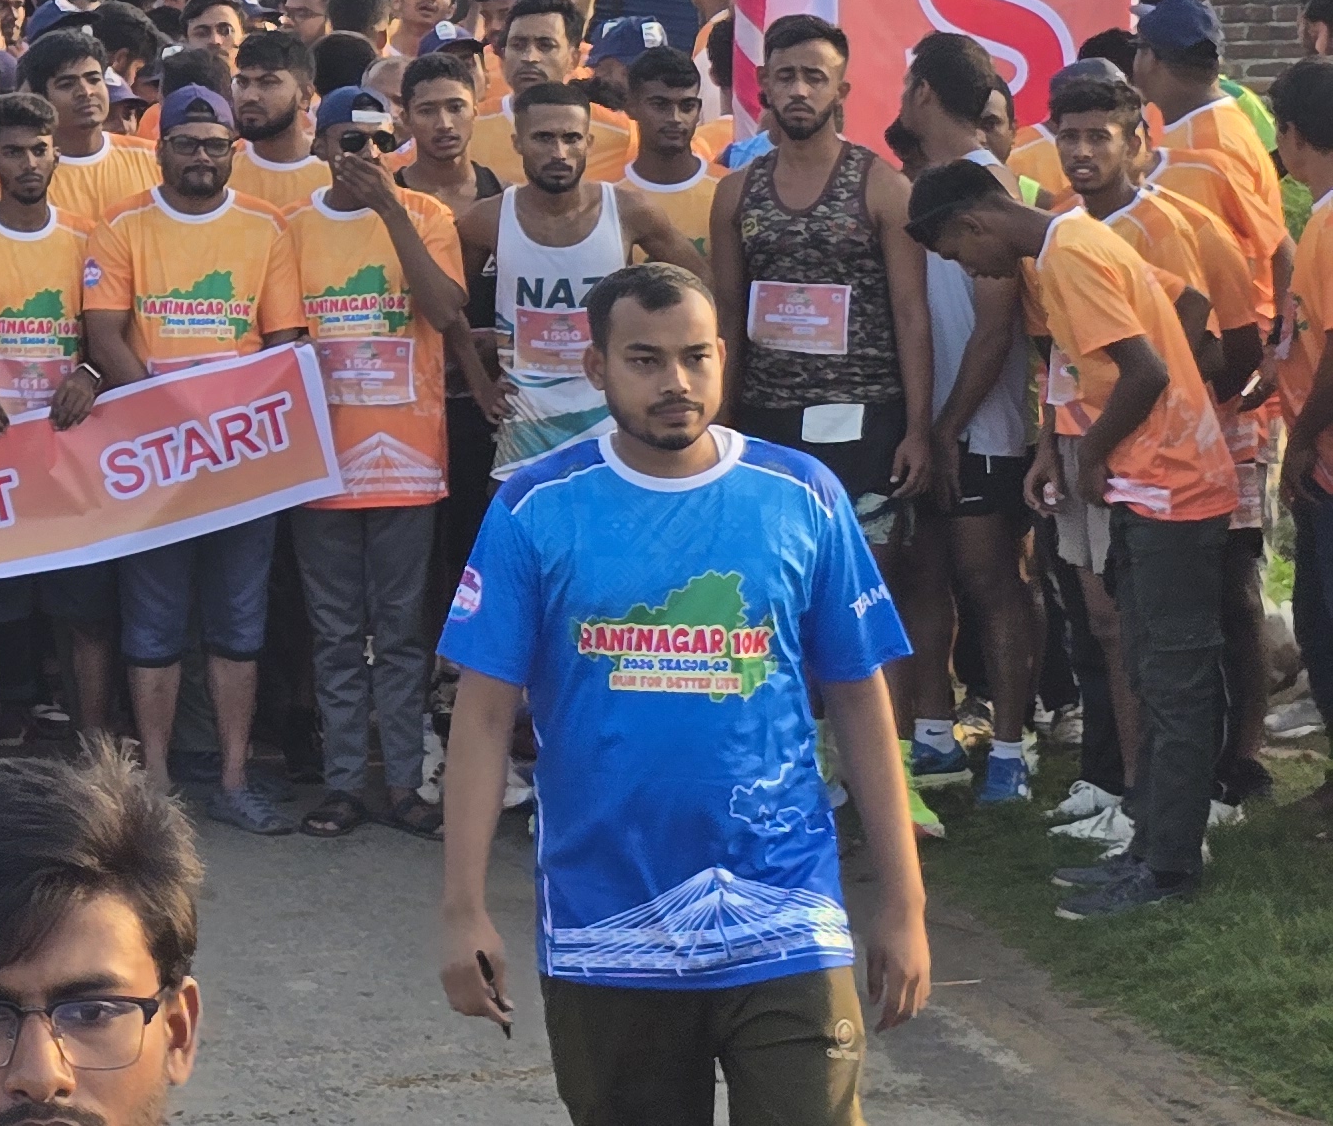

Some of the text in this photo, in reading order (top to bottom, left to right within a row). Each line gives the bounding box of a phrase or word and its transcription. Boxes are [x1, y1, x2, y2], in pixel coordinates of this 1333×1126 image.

[229, 304, 251, 317] 10K
[305, 296, 378, 314] ANINAGAR
[104, 395, 289, 496] START
[581, 626, 770, 655] RANINAGAR 10K
[657, 658, 729, 672] SEASON-02
[640, 676, 663, 688] FOR
[666, 676, 712, 689] BETTER
